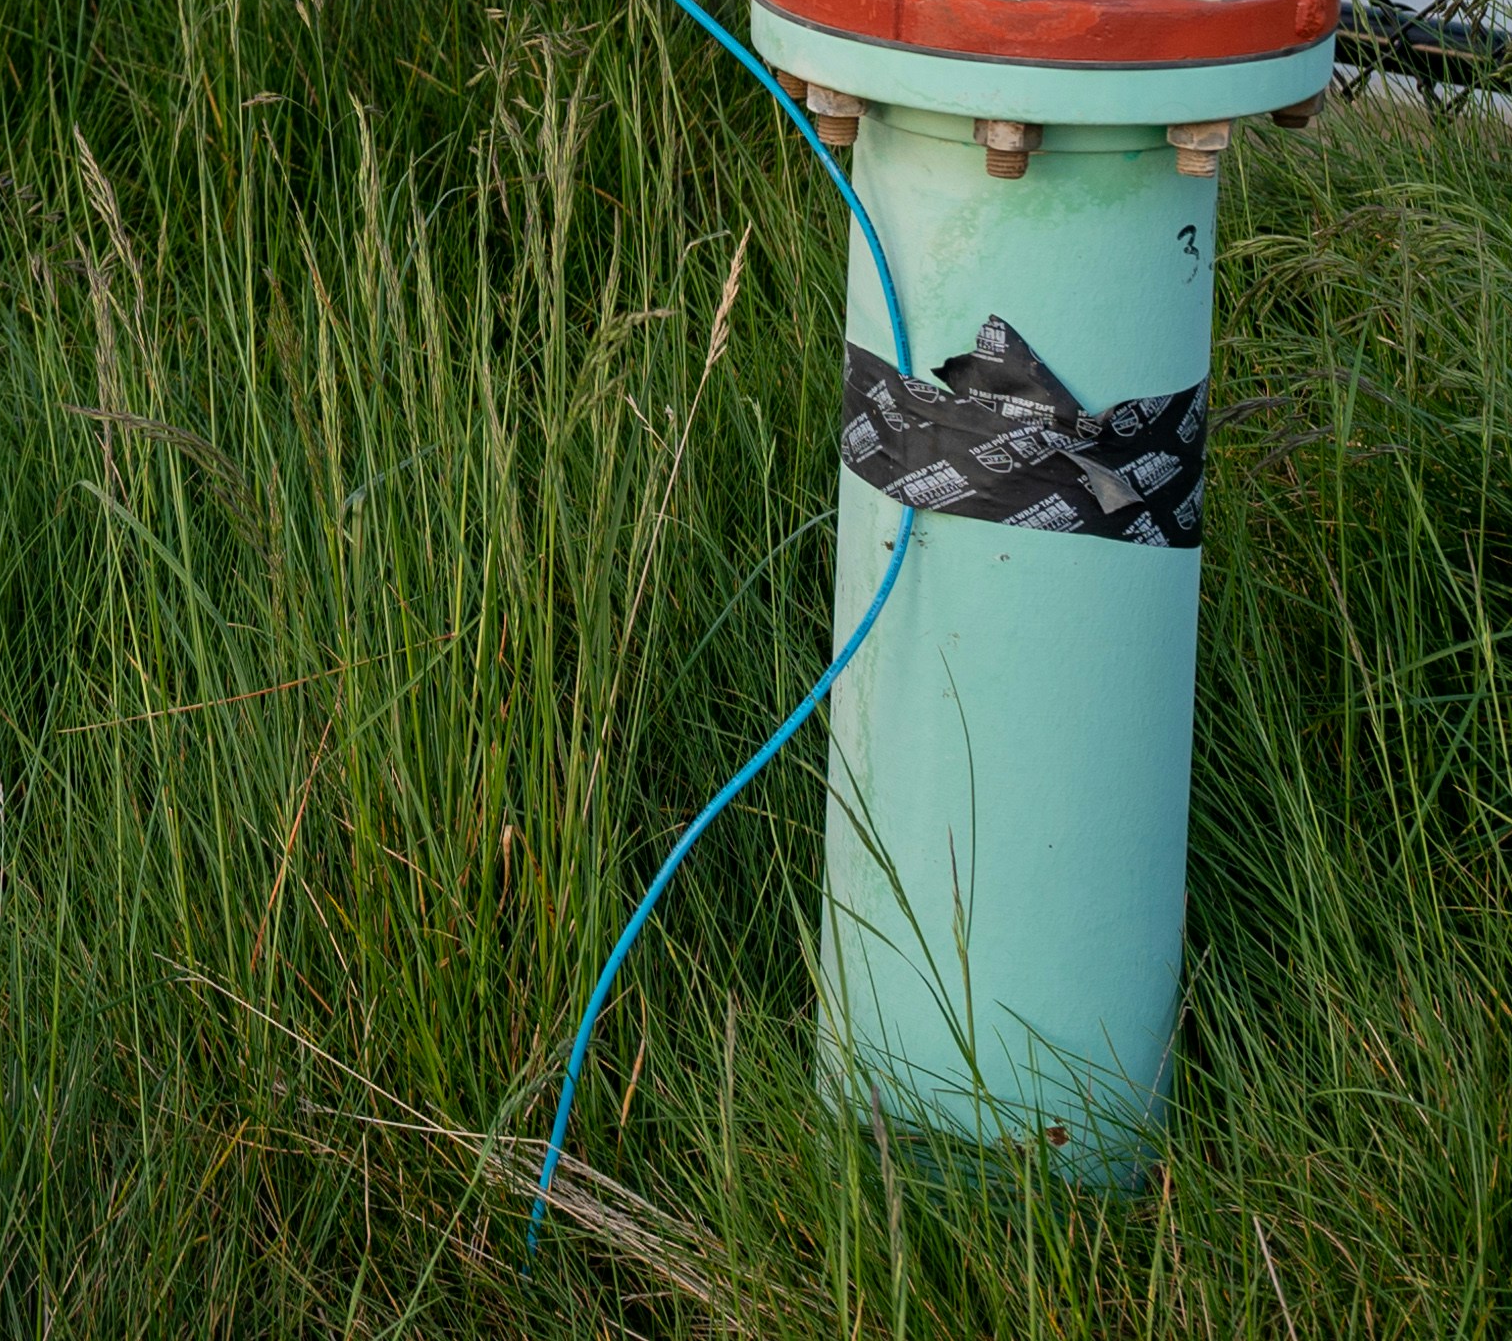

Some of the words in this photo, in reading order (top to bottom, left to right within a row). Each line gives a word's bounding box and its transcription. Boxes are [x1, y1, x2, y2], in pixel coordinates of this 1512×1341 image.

[1011, 395, 1036, 409] WRAP
[1034, 402, 1056, 413] TAPE
[904, 467, 928, 483] WRAP
[926, 459, 950, 472] TAPE
[1014, 504, 1041, 520] WRAP
[1038, 492, 1062, 508] TAPE
